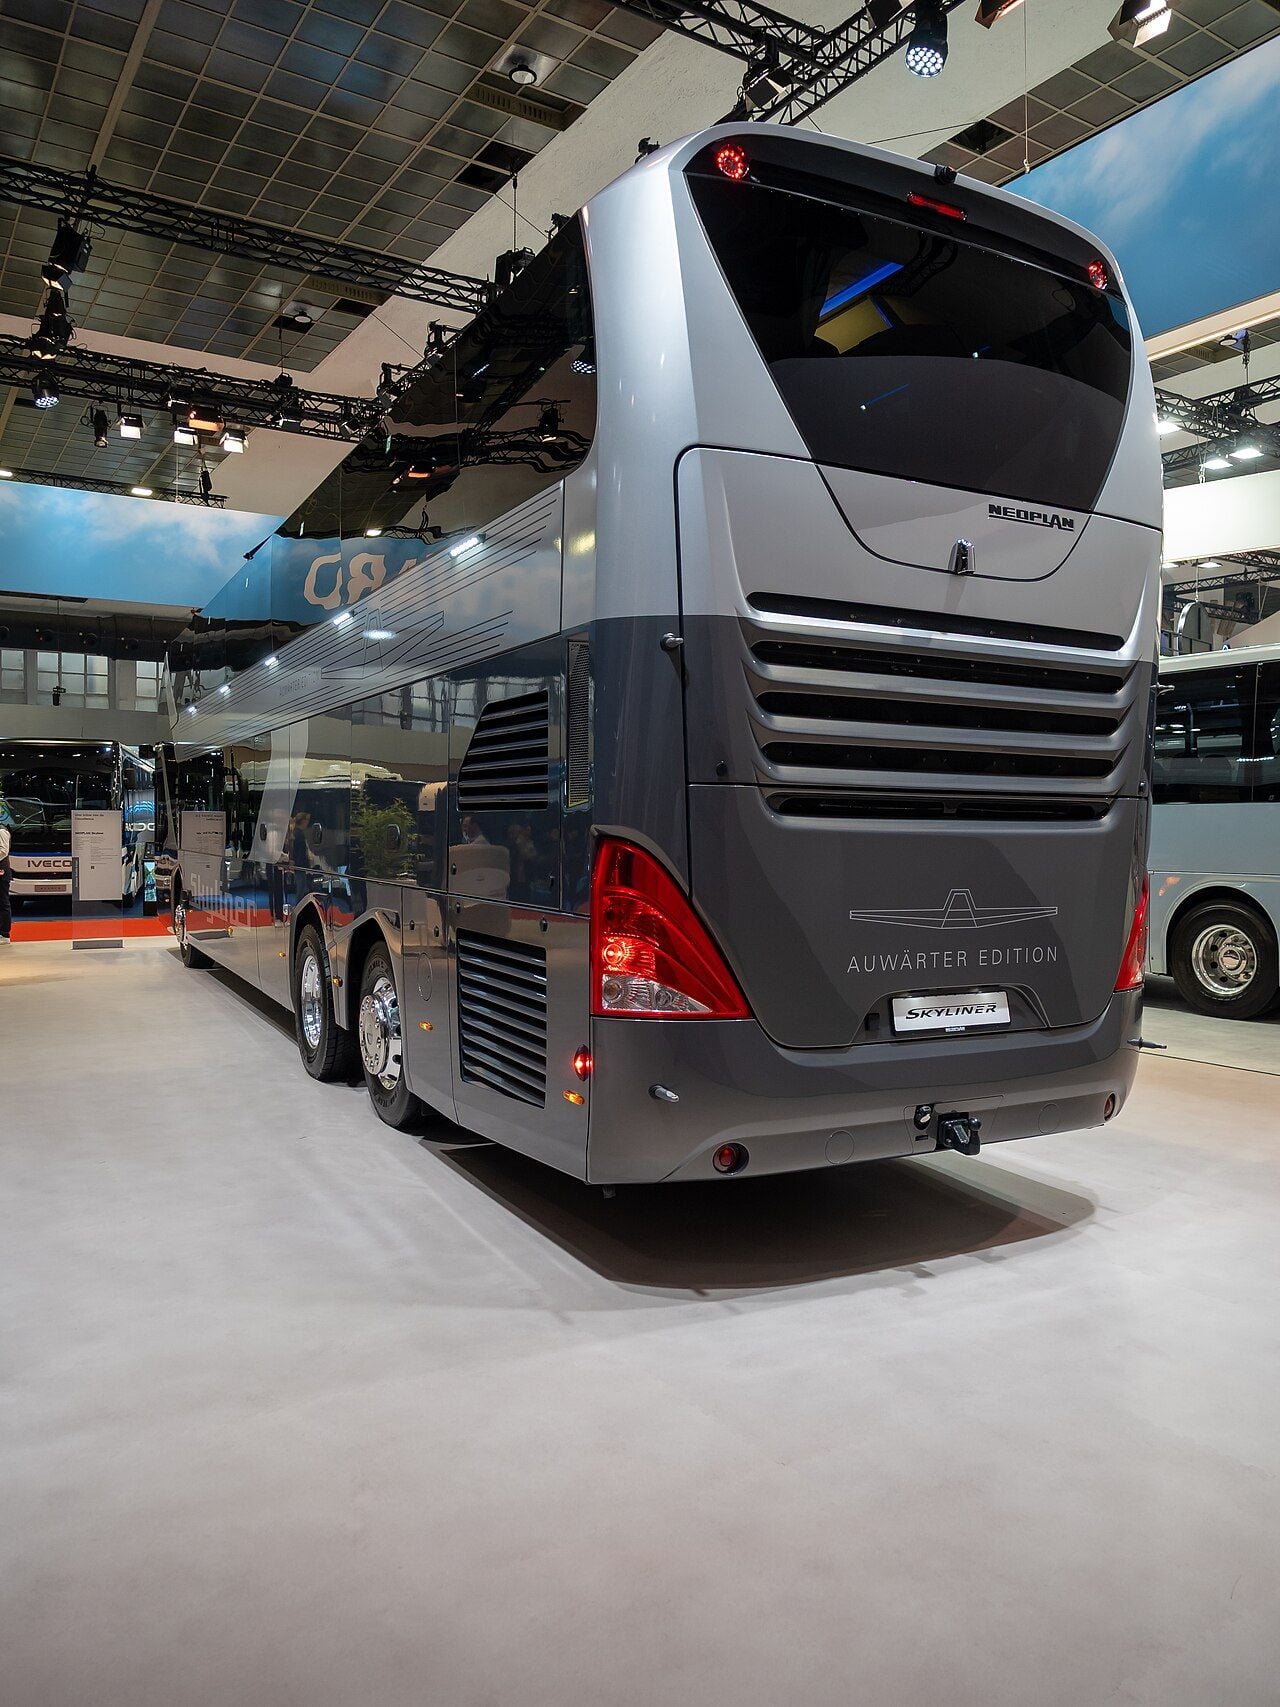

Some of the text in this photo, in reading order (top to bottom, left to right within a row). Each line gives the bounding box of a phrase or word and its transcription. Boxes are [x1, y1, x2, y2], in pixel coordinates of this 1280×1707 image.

[989, 504, 1074, 530] NEOPLAN
[27, 860, 72, 868] IVECO
[847, 946, 1057, 973] AUWÄRTER EDITION
[906, 1003, 997, 1020] SKYLINER
